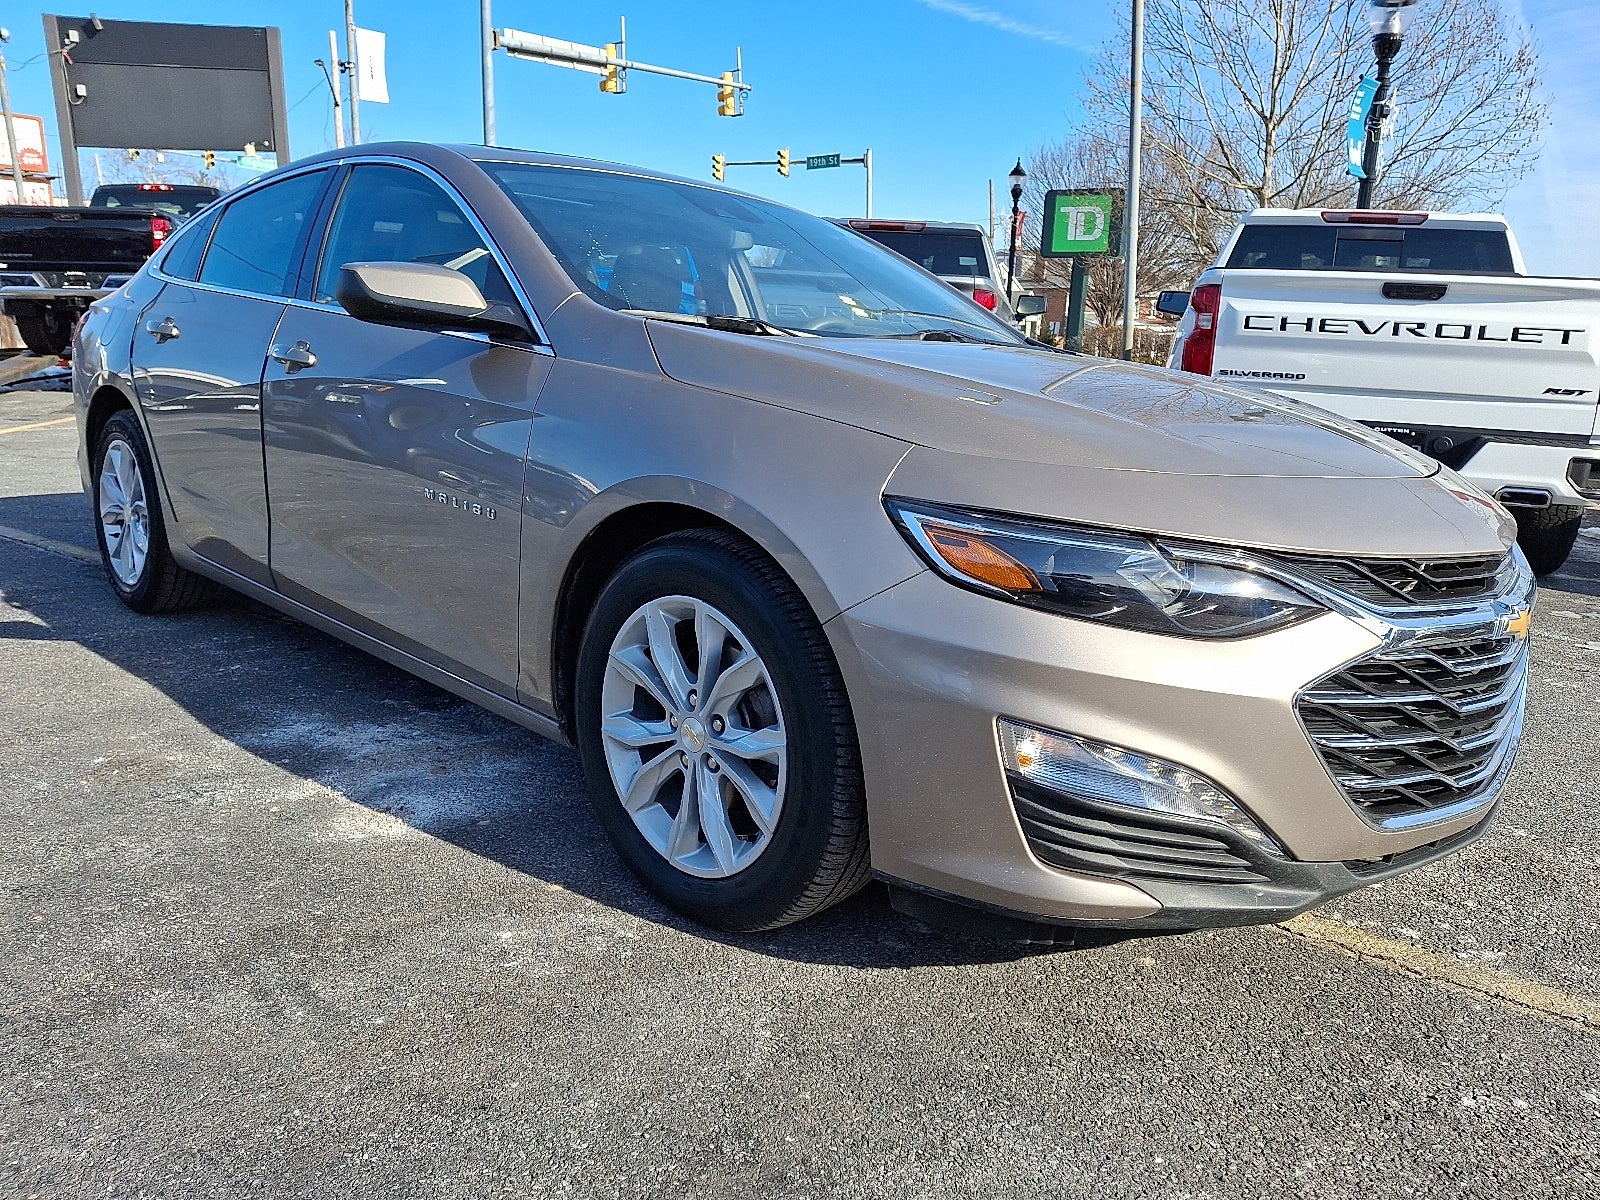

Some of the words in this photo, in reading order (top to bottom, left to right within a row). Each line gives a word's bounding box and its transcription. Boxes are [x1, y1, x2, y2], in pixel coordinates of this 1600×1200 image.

[809, 156, 827, 167] 19th
[829, 154, 838, 165] St
[1060, 206, 1105, 241] TD
[1243, 315, 1586, 345] CHEVROLET
[1218, 369, 1306, 380] SILVERADO
[1541, 387, 1593, 397] RST
[423, 487, 497, 520] MALIBU
